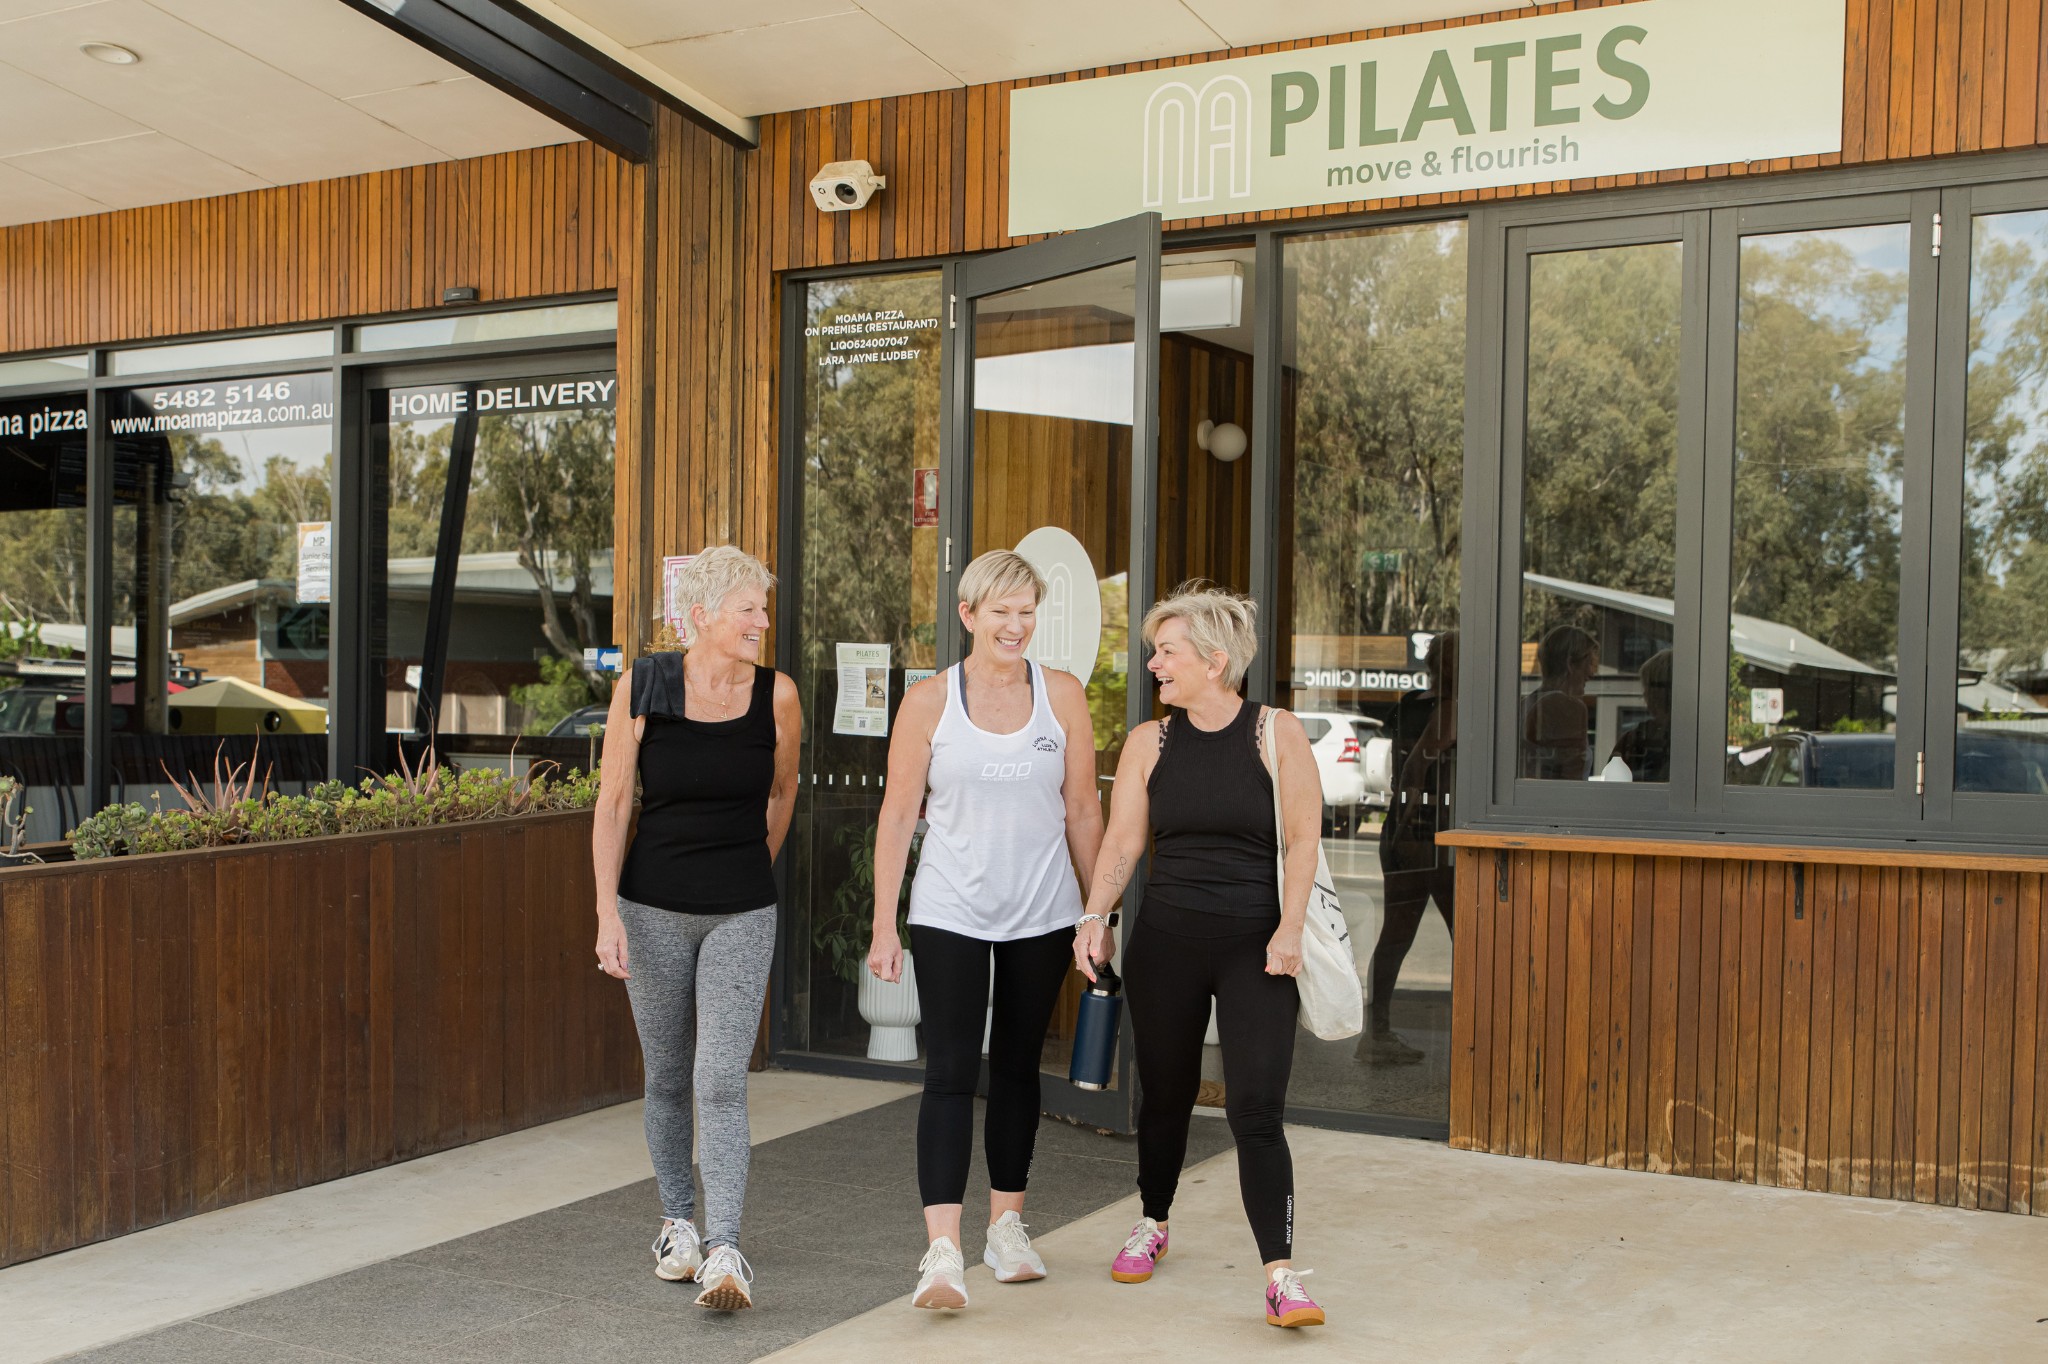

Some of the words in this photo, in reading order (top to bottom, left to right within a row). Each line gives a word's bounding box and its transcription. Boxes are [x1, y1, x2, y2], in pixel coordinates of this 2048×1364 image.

[1270, 26, 1651, 157] PILATES
[1326, 156, 1411, 188] move
[1420, 150, 1443, 178] &
[1450, 135, 1580, 174] flourish
[804, 327, 820, 337] ON
[821, 323, 863, 336] PREMISE
[864, 318, 938, 334] (RESTAURANT)
[836, 313, 872, 323] MOAMA
[876, 310, 904, 320] PIZZA
[819, 355, 846, 366] LARA
[847, 352, 879, 364] JAYNE
[880, 349, 921, 362] LUDBEY
[153, 388, 216, 410] 5482
[225, 381, 290, 404] 5146
[390, 390, 468, 416] HOME
[476, 379, 615, 411] DELIVERY
[29, 406, 88, 440] pizza
[110, 402, 333, 434] www.moamapizza.com.au
[856, 650, 880, 658] PILATES
